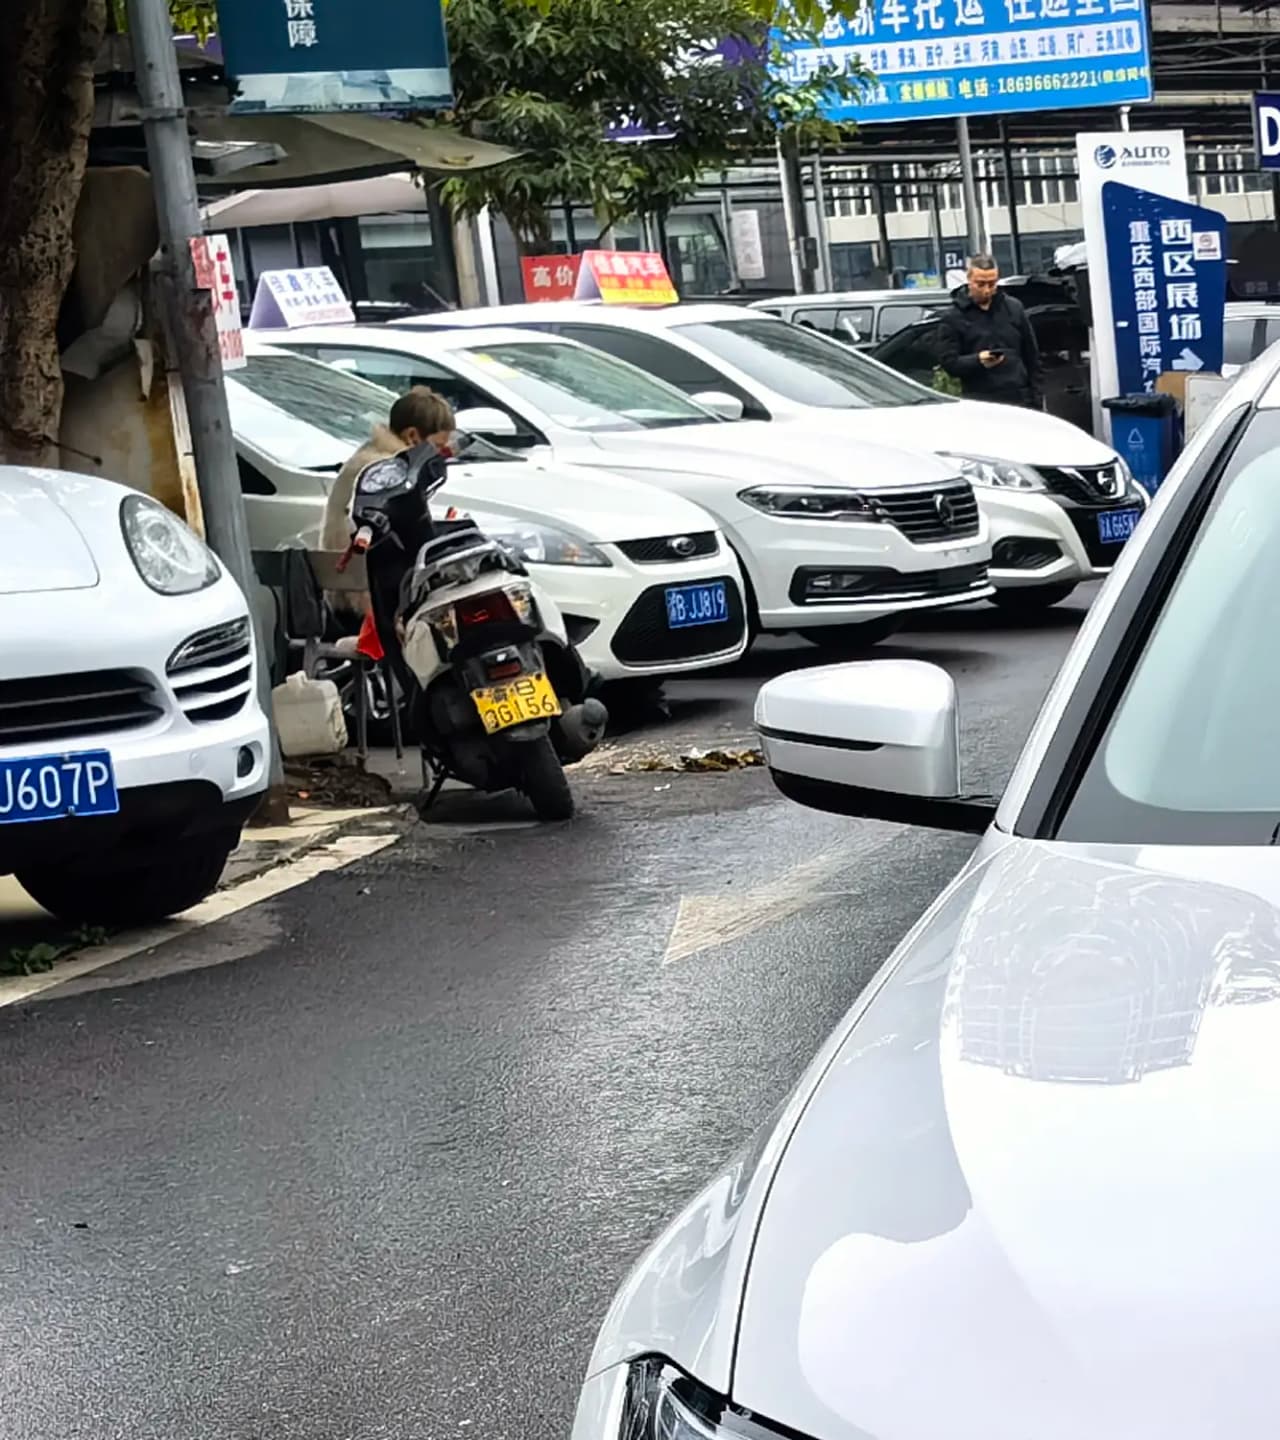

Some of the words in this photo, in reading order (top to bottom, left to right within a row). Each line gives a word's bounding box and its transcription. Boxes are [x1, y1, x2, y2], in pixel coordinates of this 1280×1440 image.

[1120, 146, 1170, 159] AUTO
[531, 264, 573, 287] 高价
[1160, 219, 1202, 340] 西区展场
